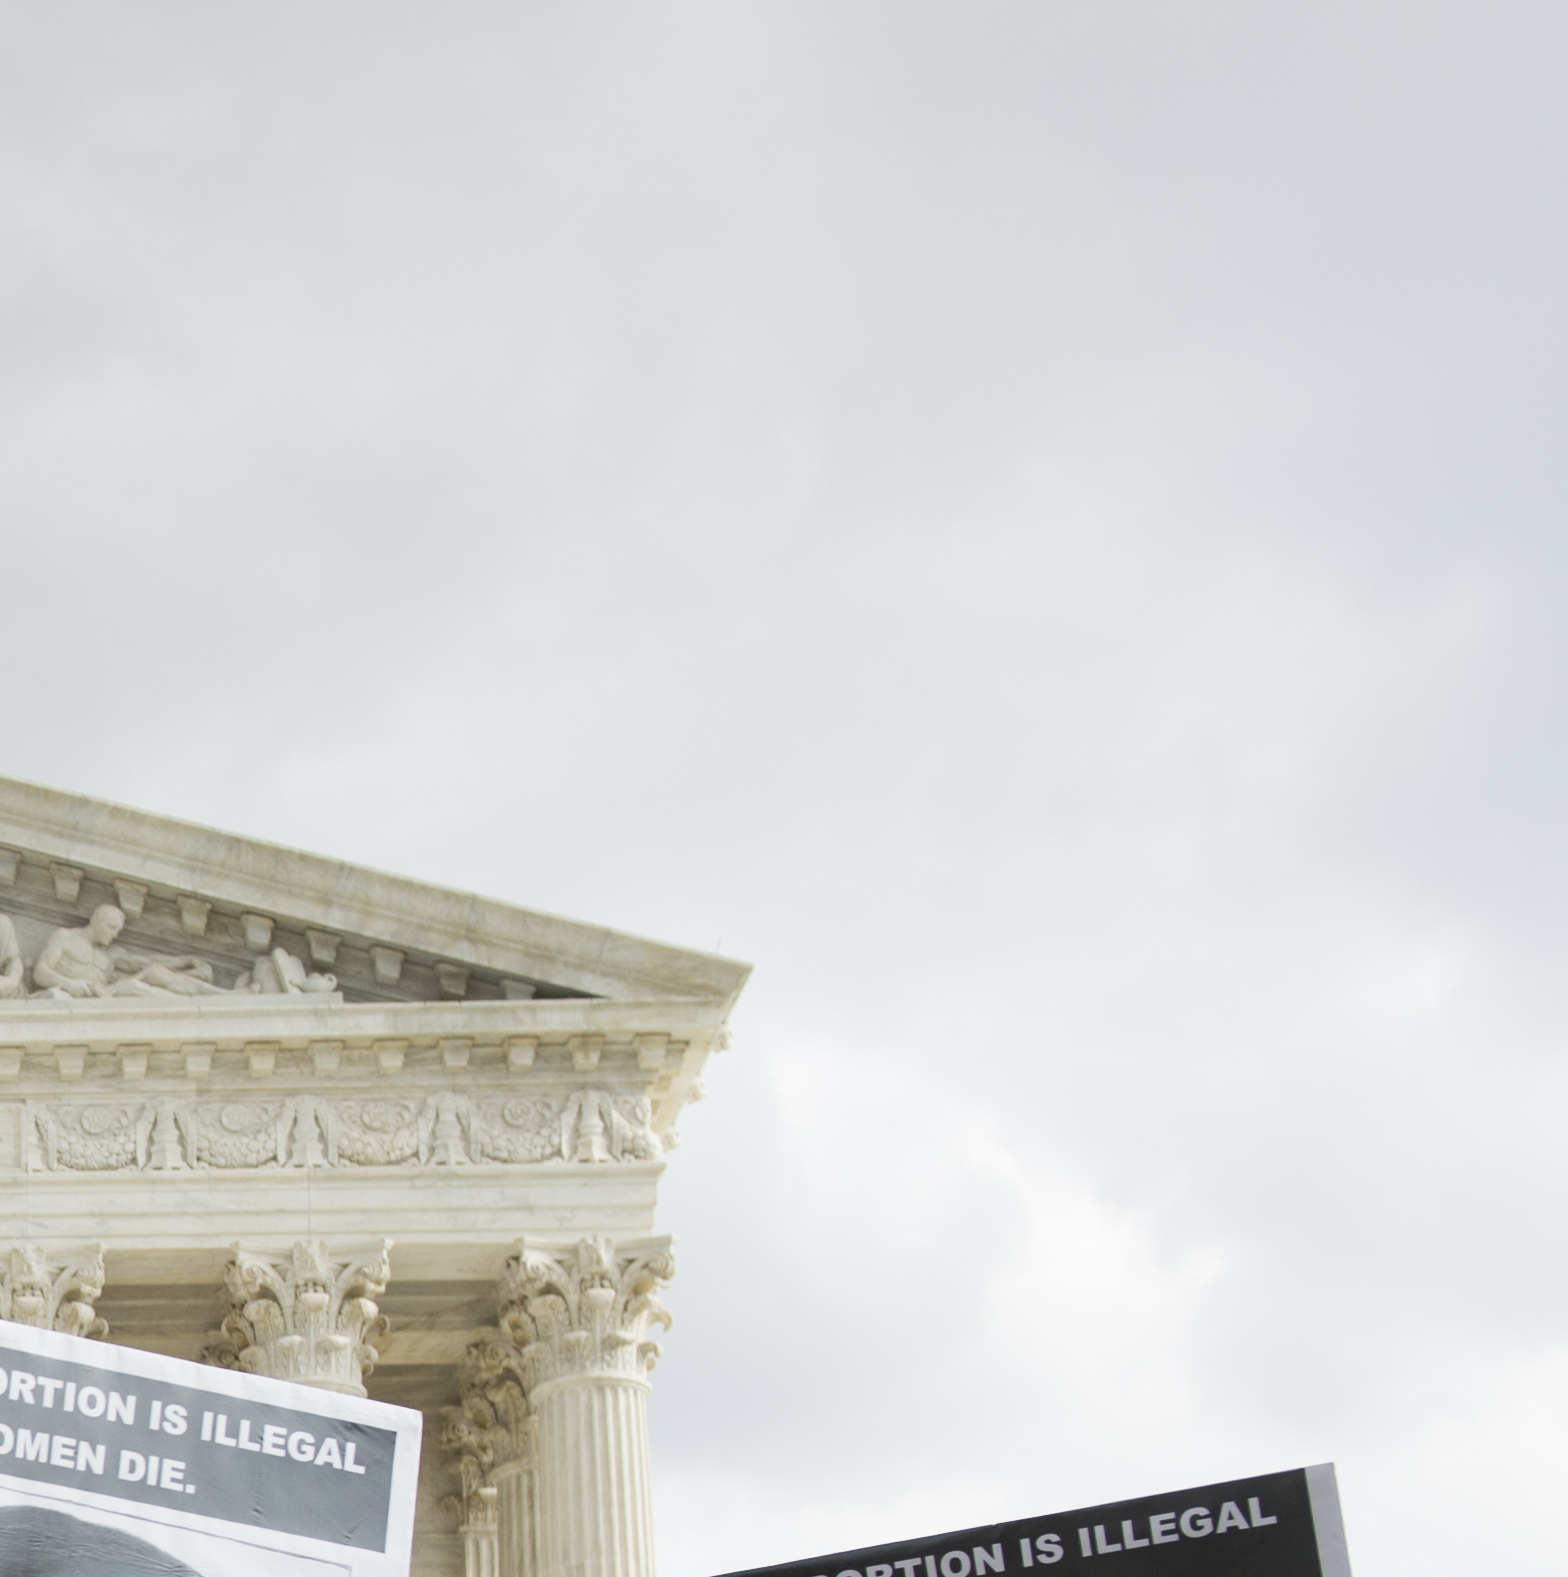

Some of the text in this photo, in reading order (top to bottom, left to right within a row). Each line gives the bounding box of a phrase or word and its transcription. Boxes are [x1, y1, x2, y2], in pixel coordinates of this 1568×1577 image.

[117, 1449, 196, 1494] DIE.
[149, 1399, 188, 1437] IS
[200, 1411, 366, 1475] ILLEGAL
[1020, 1532, 1065, 1569] IS
[1077, 1496, 1278, 1558] ILLEGAL
